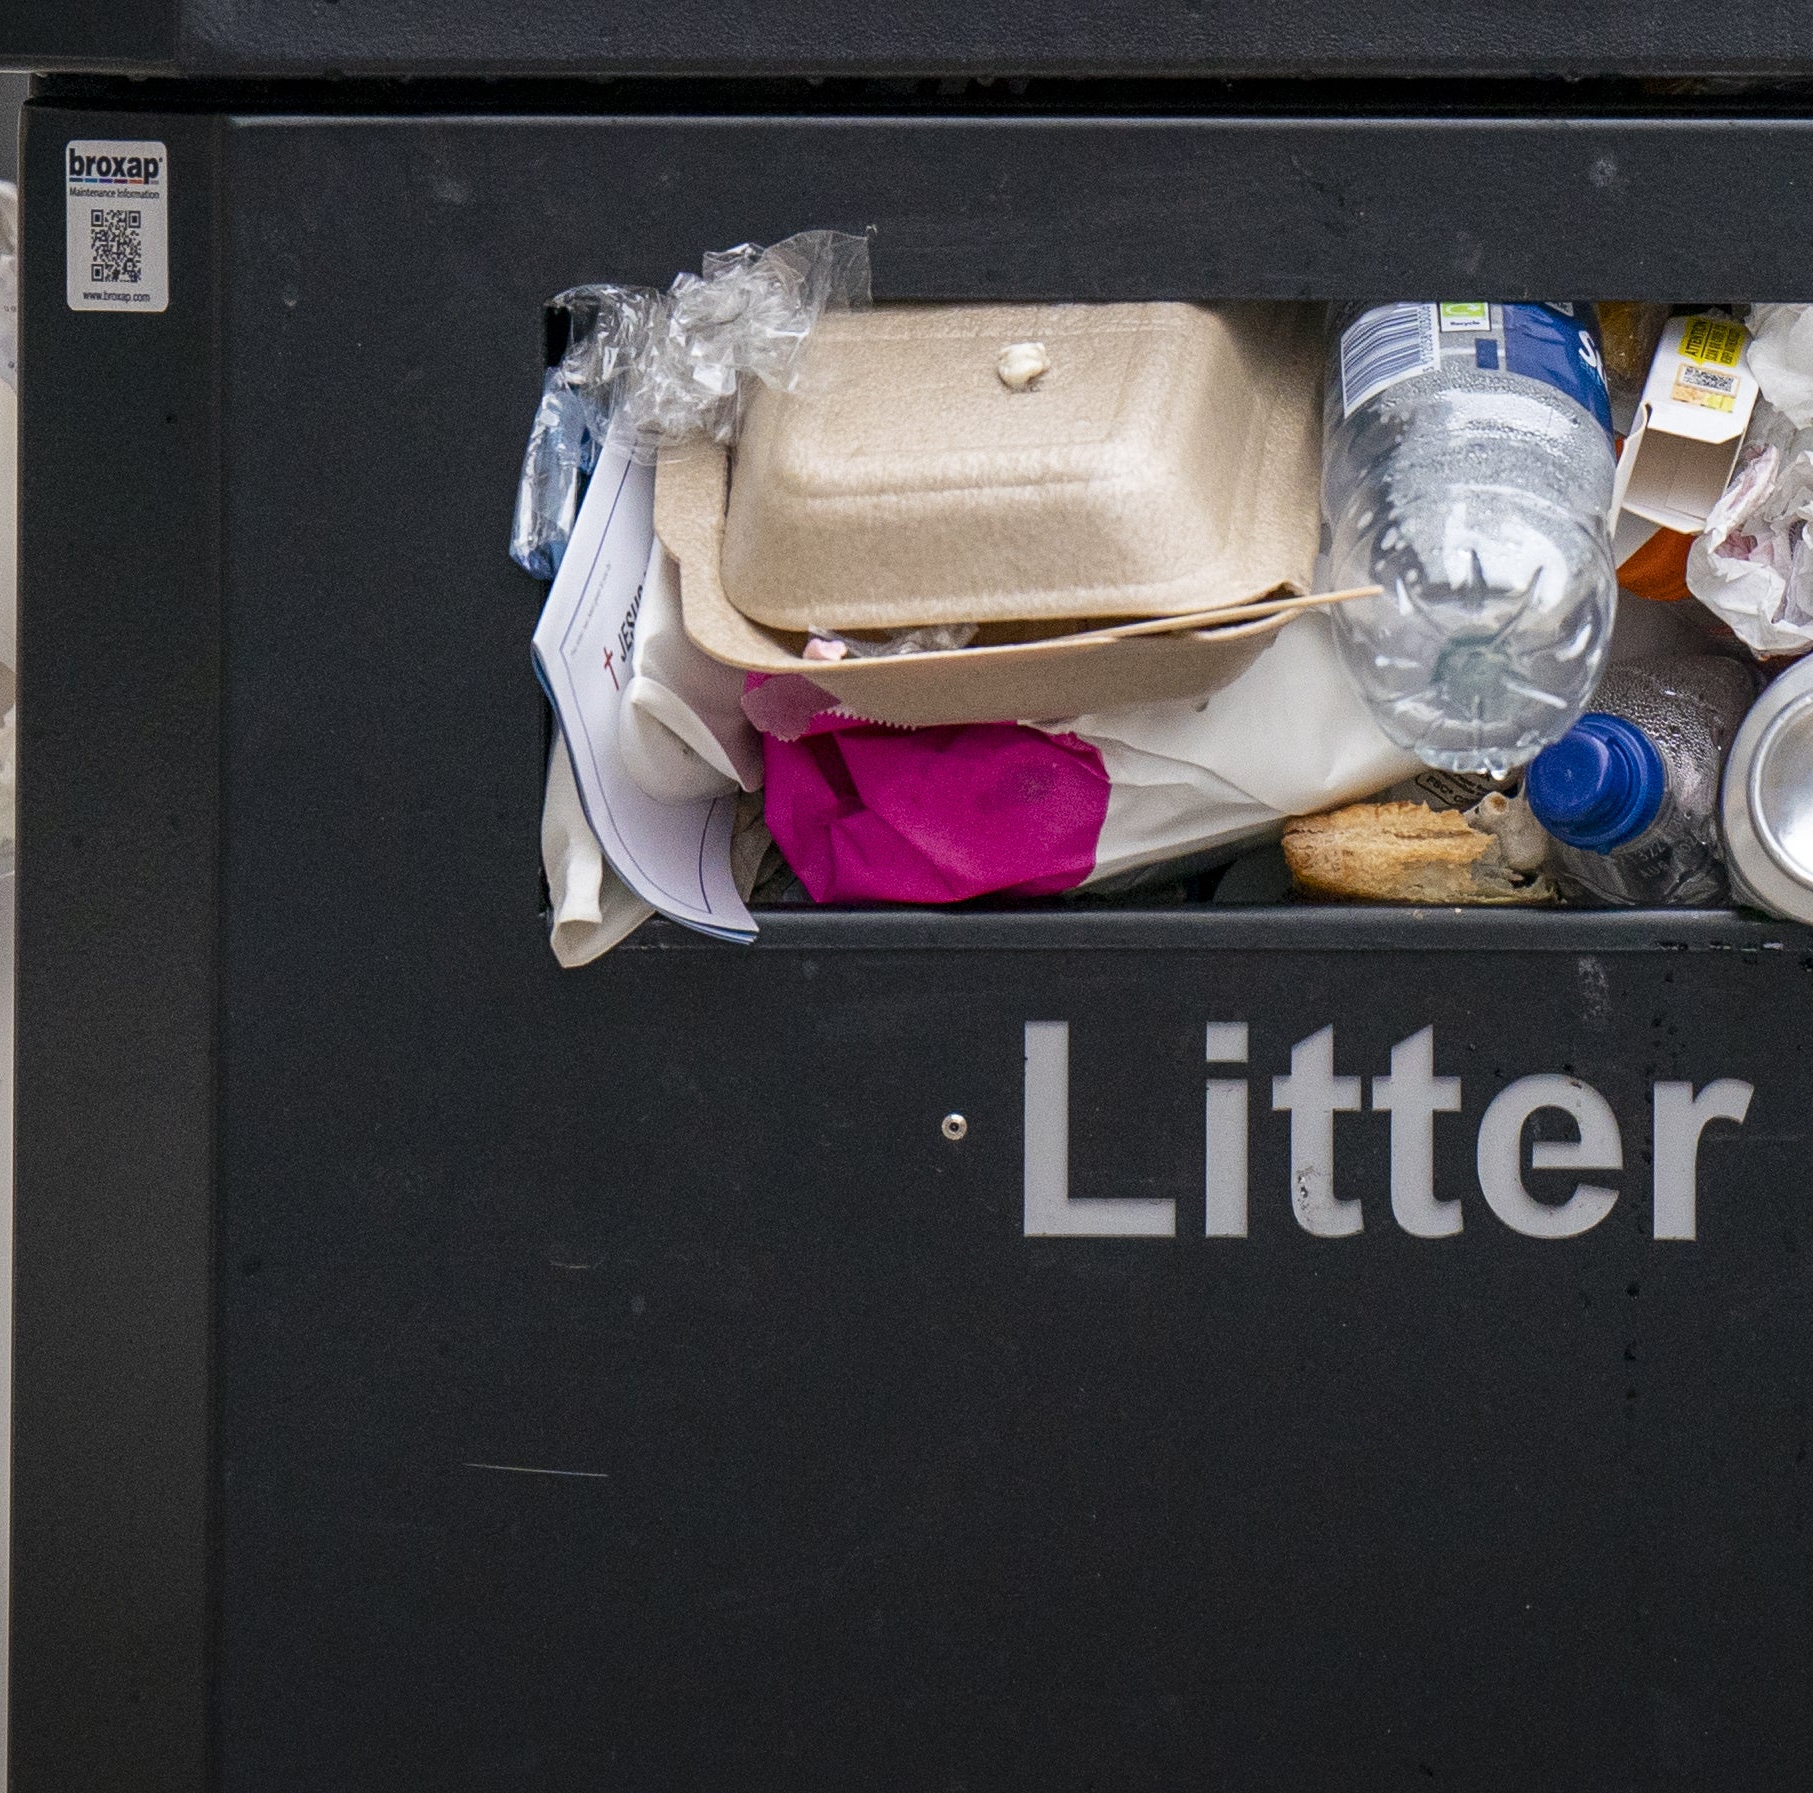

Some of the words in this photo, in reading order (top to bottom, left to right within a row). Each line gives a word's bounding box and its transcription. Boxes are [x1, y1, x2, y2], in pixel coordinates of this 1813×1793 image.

[69, 148, 160, 185] broxap
[69, 187, 116, 199] Maintenance
[116, 187, 160, 200] Information
[83, 291, 151, 304] www.broxap.com
[1023, 1019, 1755, 1240] Litter
